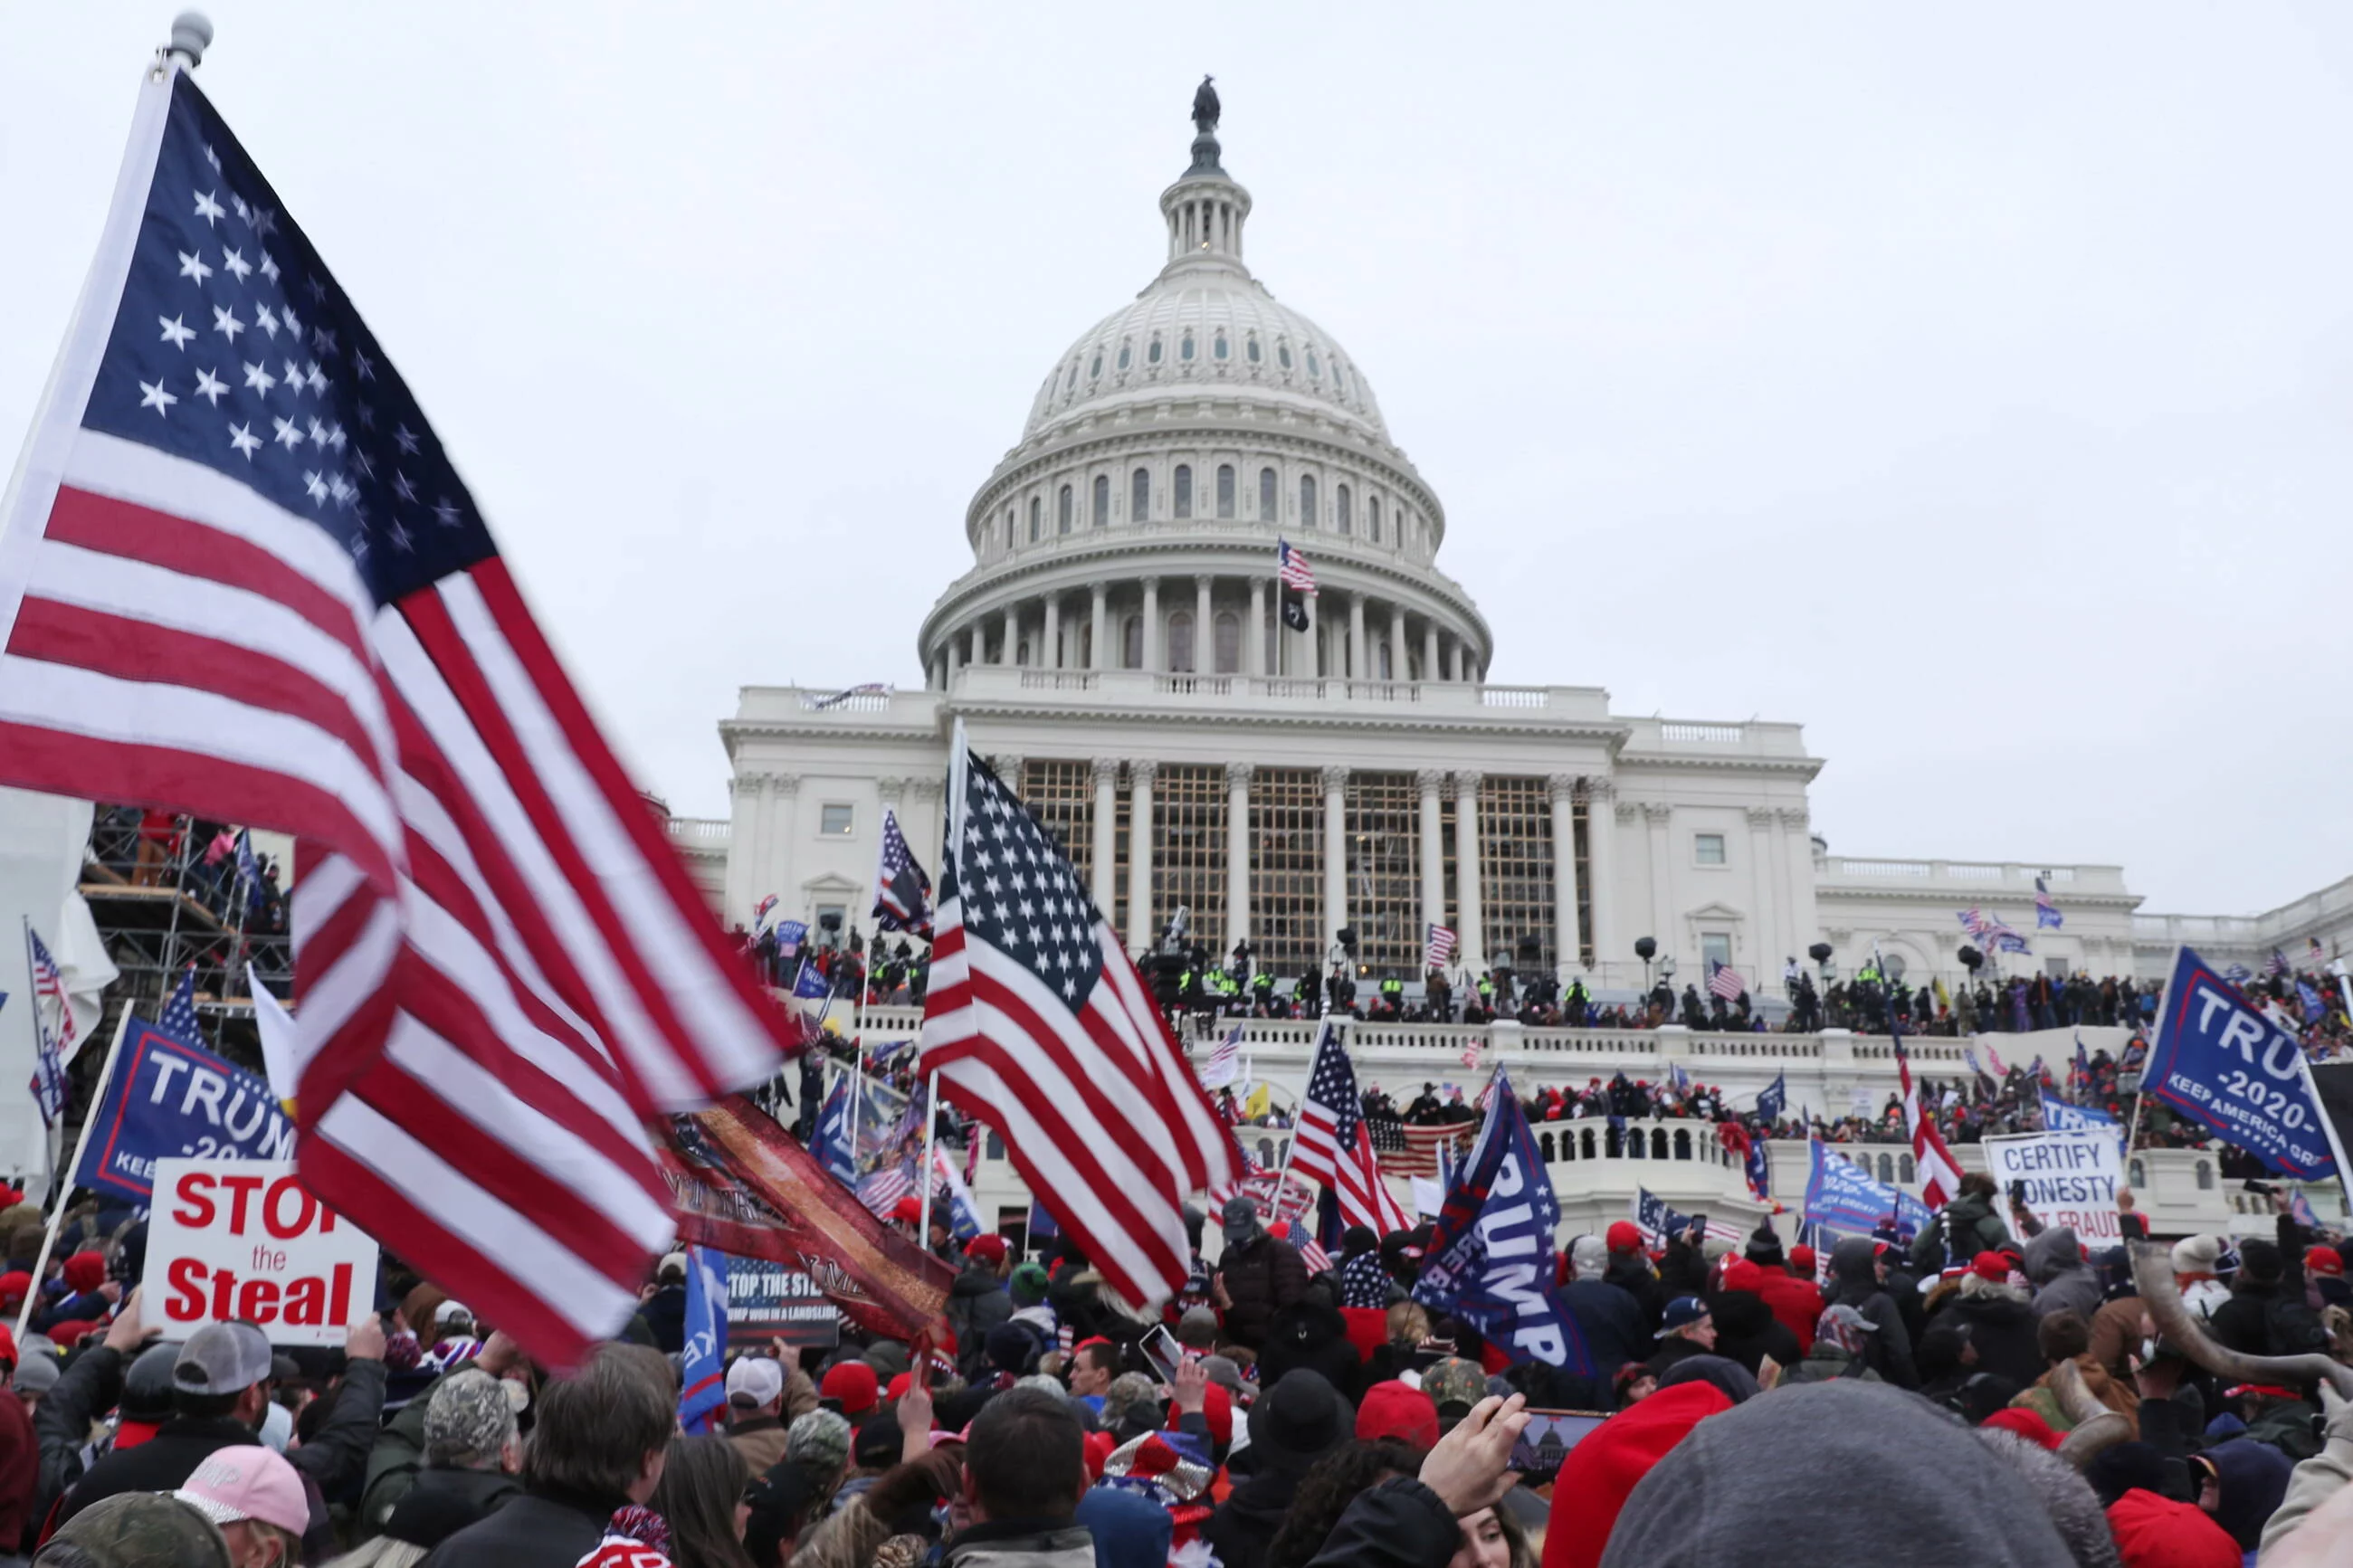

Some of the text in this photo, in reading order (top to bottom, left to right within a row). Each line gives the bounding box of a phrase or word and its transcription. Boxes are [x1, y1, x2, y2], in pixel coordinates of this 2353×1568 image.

[2197, 986, 2310, 1094] TRU
[2168, 1071, 2213, 1102] KEEP
[2210, 1098, 2289, 1149] AMERICA
[2218, 1070, 2315, 1133] -2020-
[115, 1150, 156, 1179] KEE
[2005, 1143, 2100, 1172] CERTIFY
[2014, 1211, 2049, 1239] NT
[252, 1244, 286, 1271] the
[1479, 1152, 1567, 1366] RUMP
[165, 1257, 353, 1326] Steal
[727, 1273, 760, 1298] TOP
[761, 1272, 789, 1297] THE
[788, 1305, 837, 1320] LANDSLIDE
